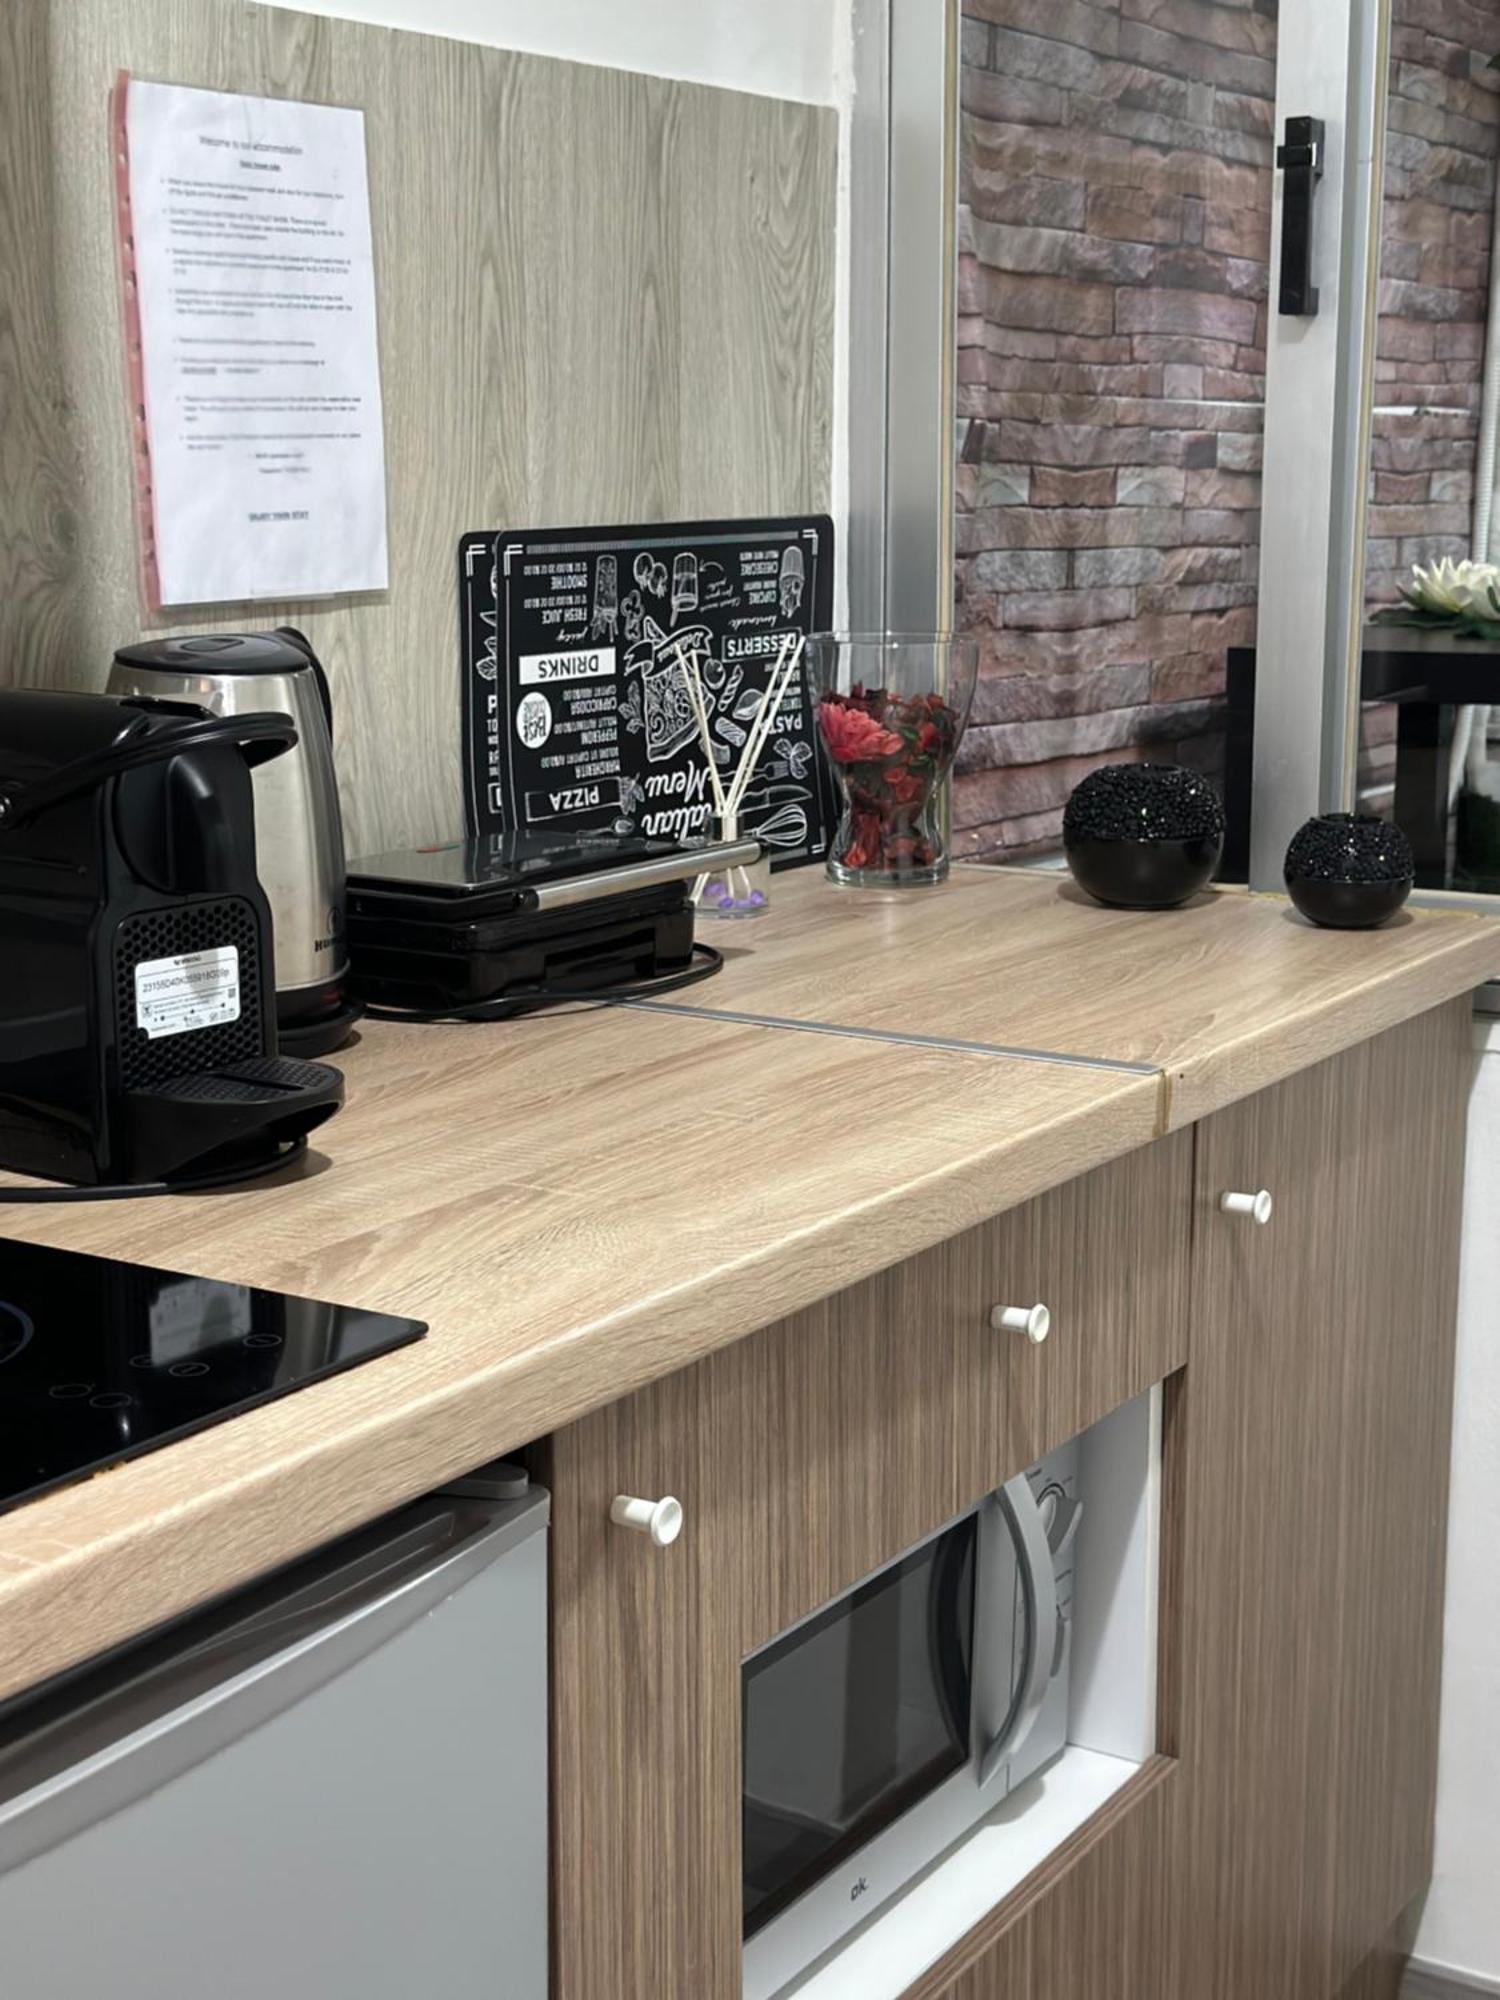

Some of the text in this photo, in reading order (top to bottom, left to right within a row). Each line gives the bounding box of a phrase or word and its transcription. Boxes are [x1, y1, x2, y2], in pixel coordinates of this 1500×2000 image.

[727, 633, 797, 657] DESSERTS
[538, 655, 600, 679] DRINKS
[644, 760, 711, 803] Menu
[548, 786, 600, 813] PIZZA
